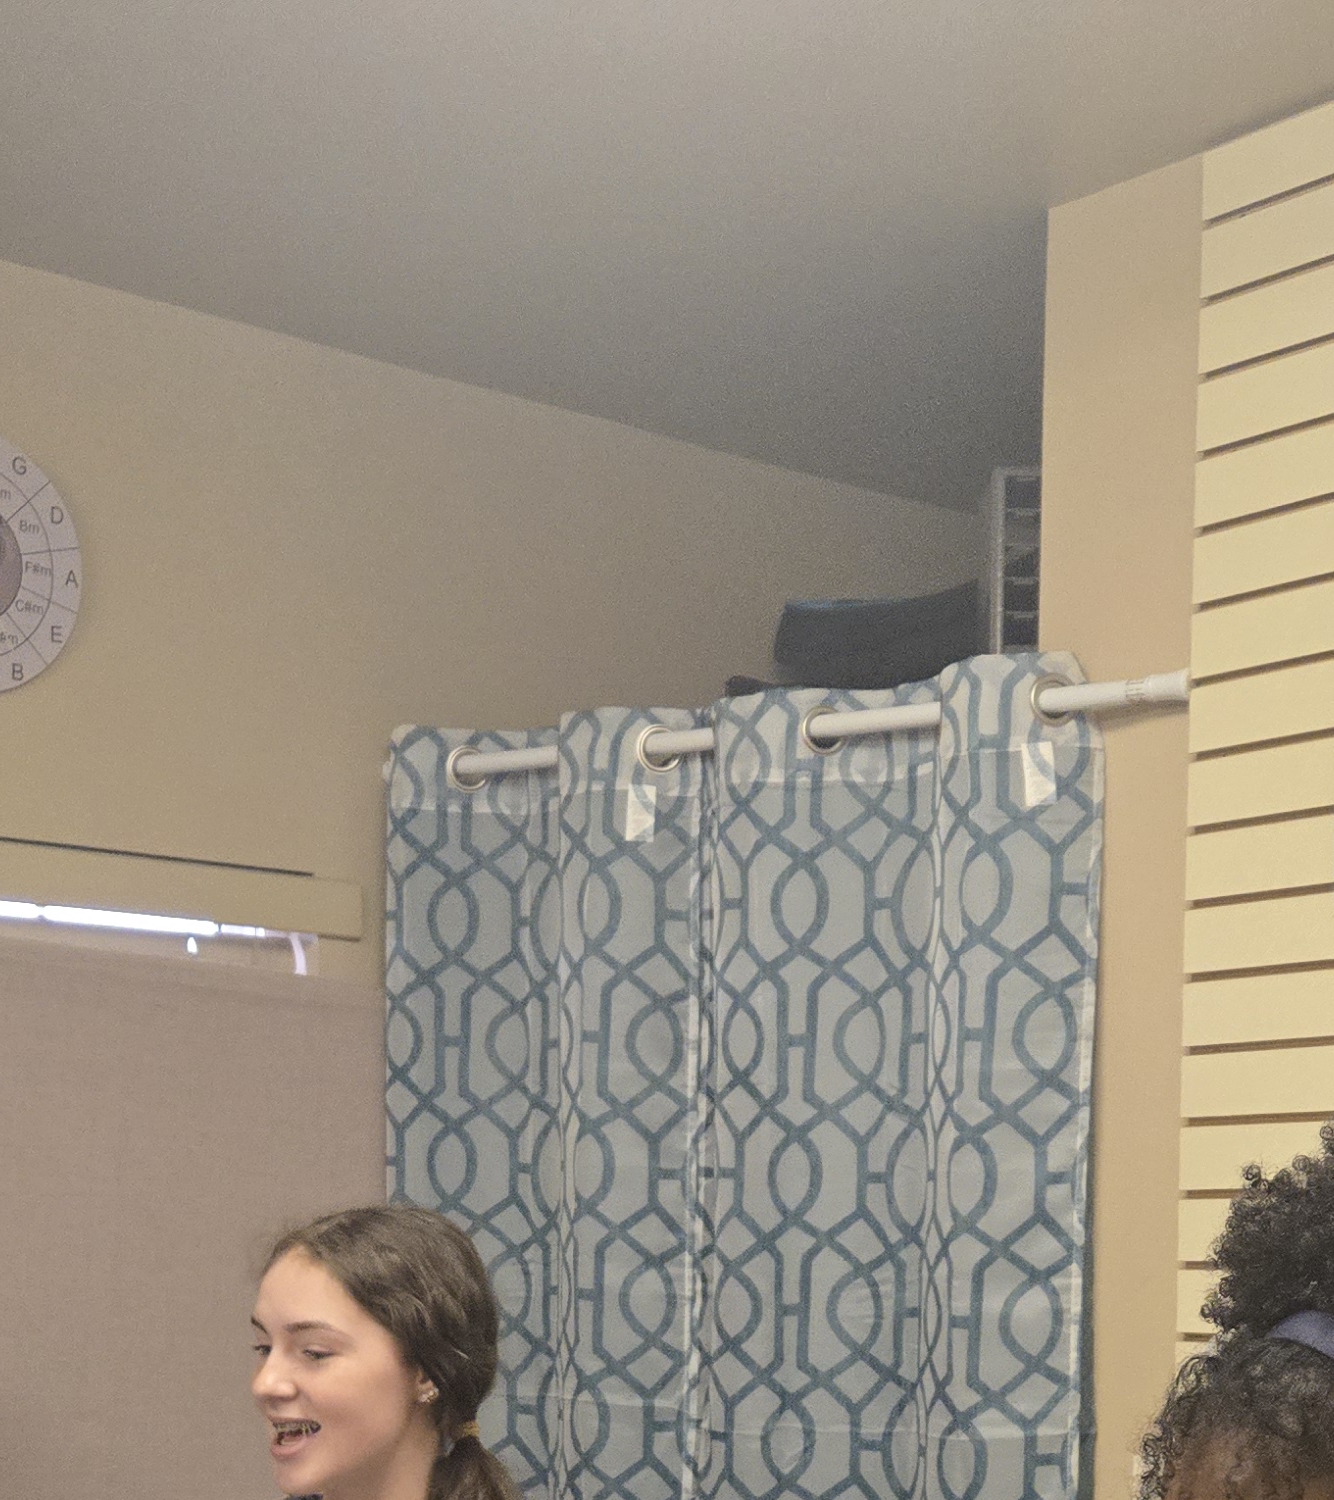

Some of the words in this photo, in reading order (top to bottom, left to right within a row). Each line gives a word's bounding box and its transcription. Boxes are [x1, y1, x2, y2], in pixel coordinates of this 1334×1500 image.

[13, 456, 27, 475] G
[51, 506, 64, 524] D
[20, 520, 39, 534] Bm
[25, 562, 51, 576] F#m
[65, 570, 78, 588] A
[16, 600, 44, 614] C#m
[51, 626, 63, 643] E
[12, 663, 23, 680] B
